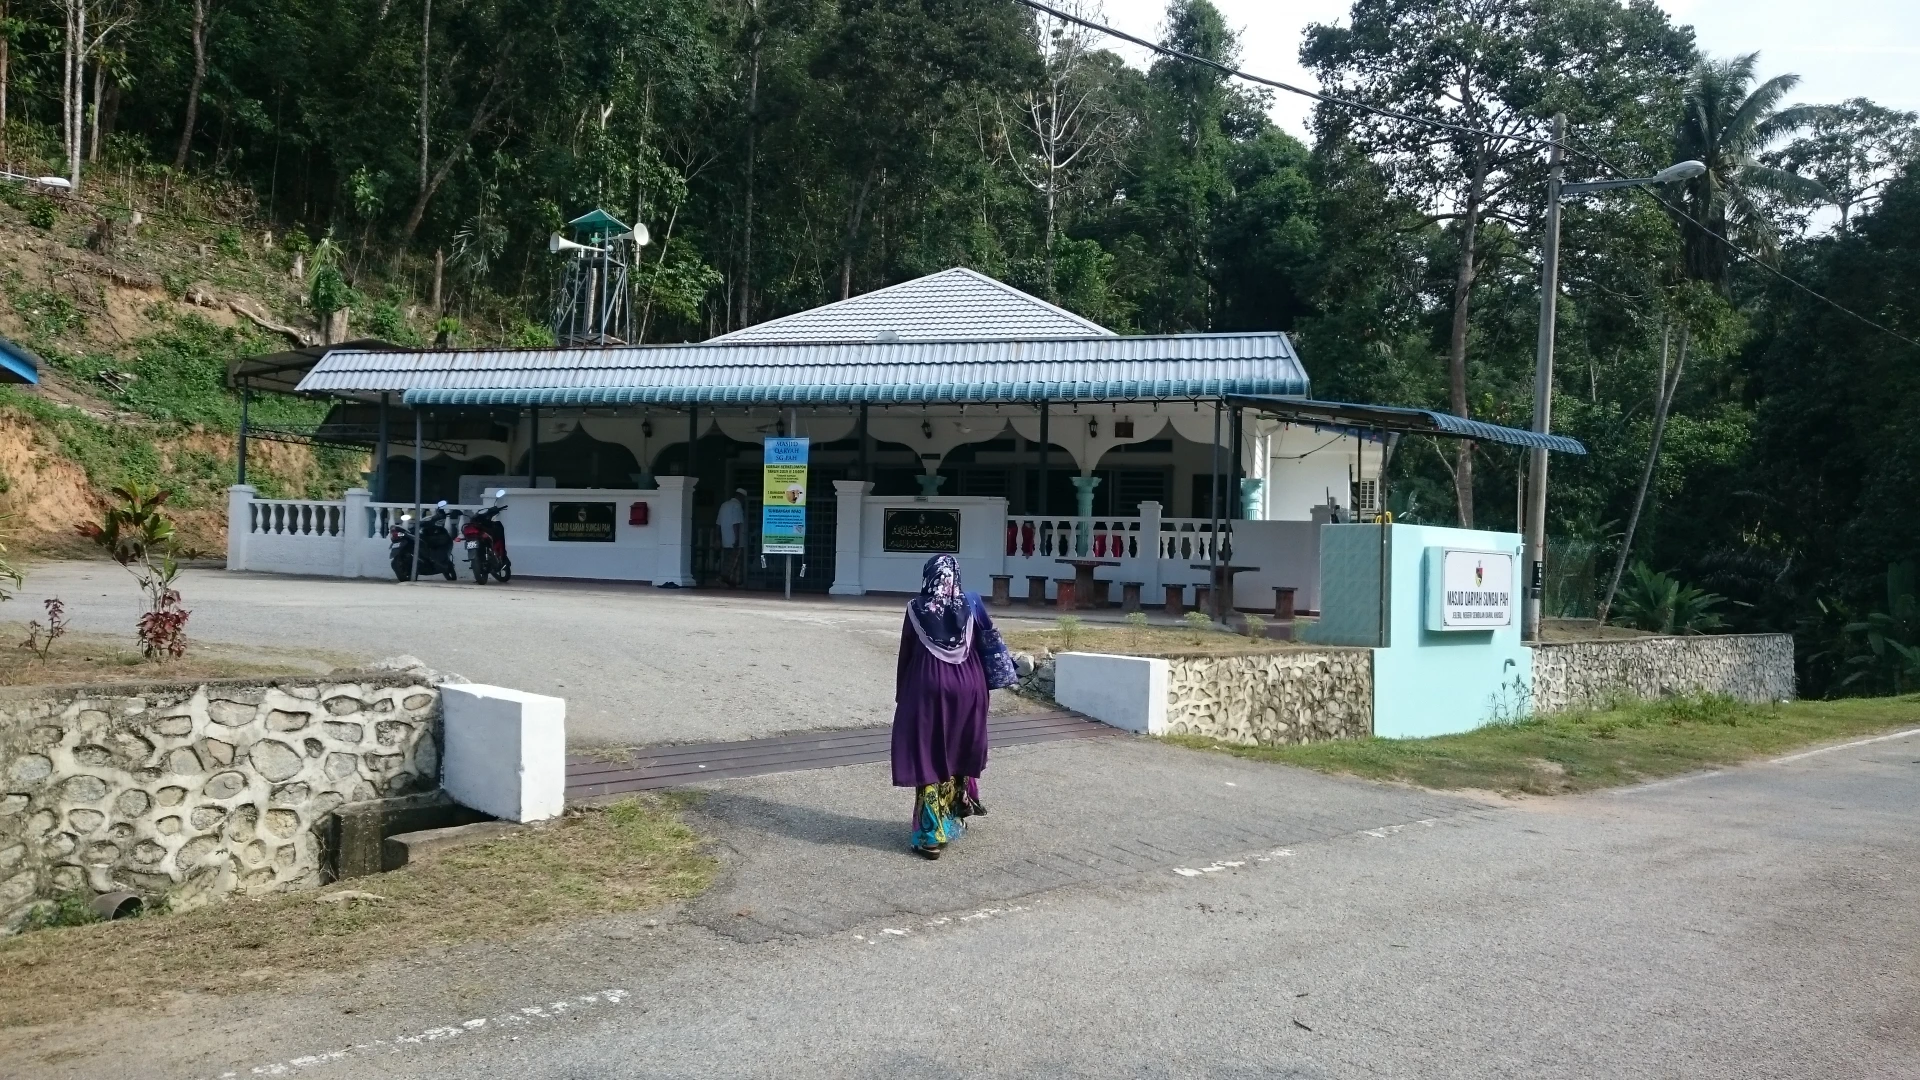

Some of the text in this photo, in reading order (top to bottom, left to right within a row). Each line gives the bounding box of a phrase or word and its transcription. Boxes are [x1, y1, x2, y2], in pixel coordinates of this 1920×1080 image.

[1447, 590, 1509, 606] MASJID QARYAH SUNGAI PAH
